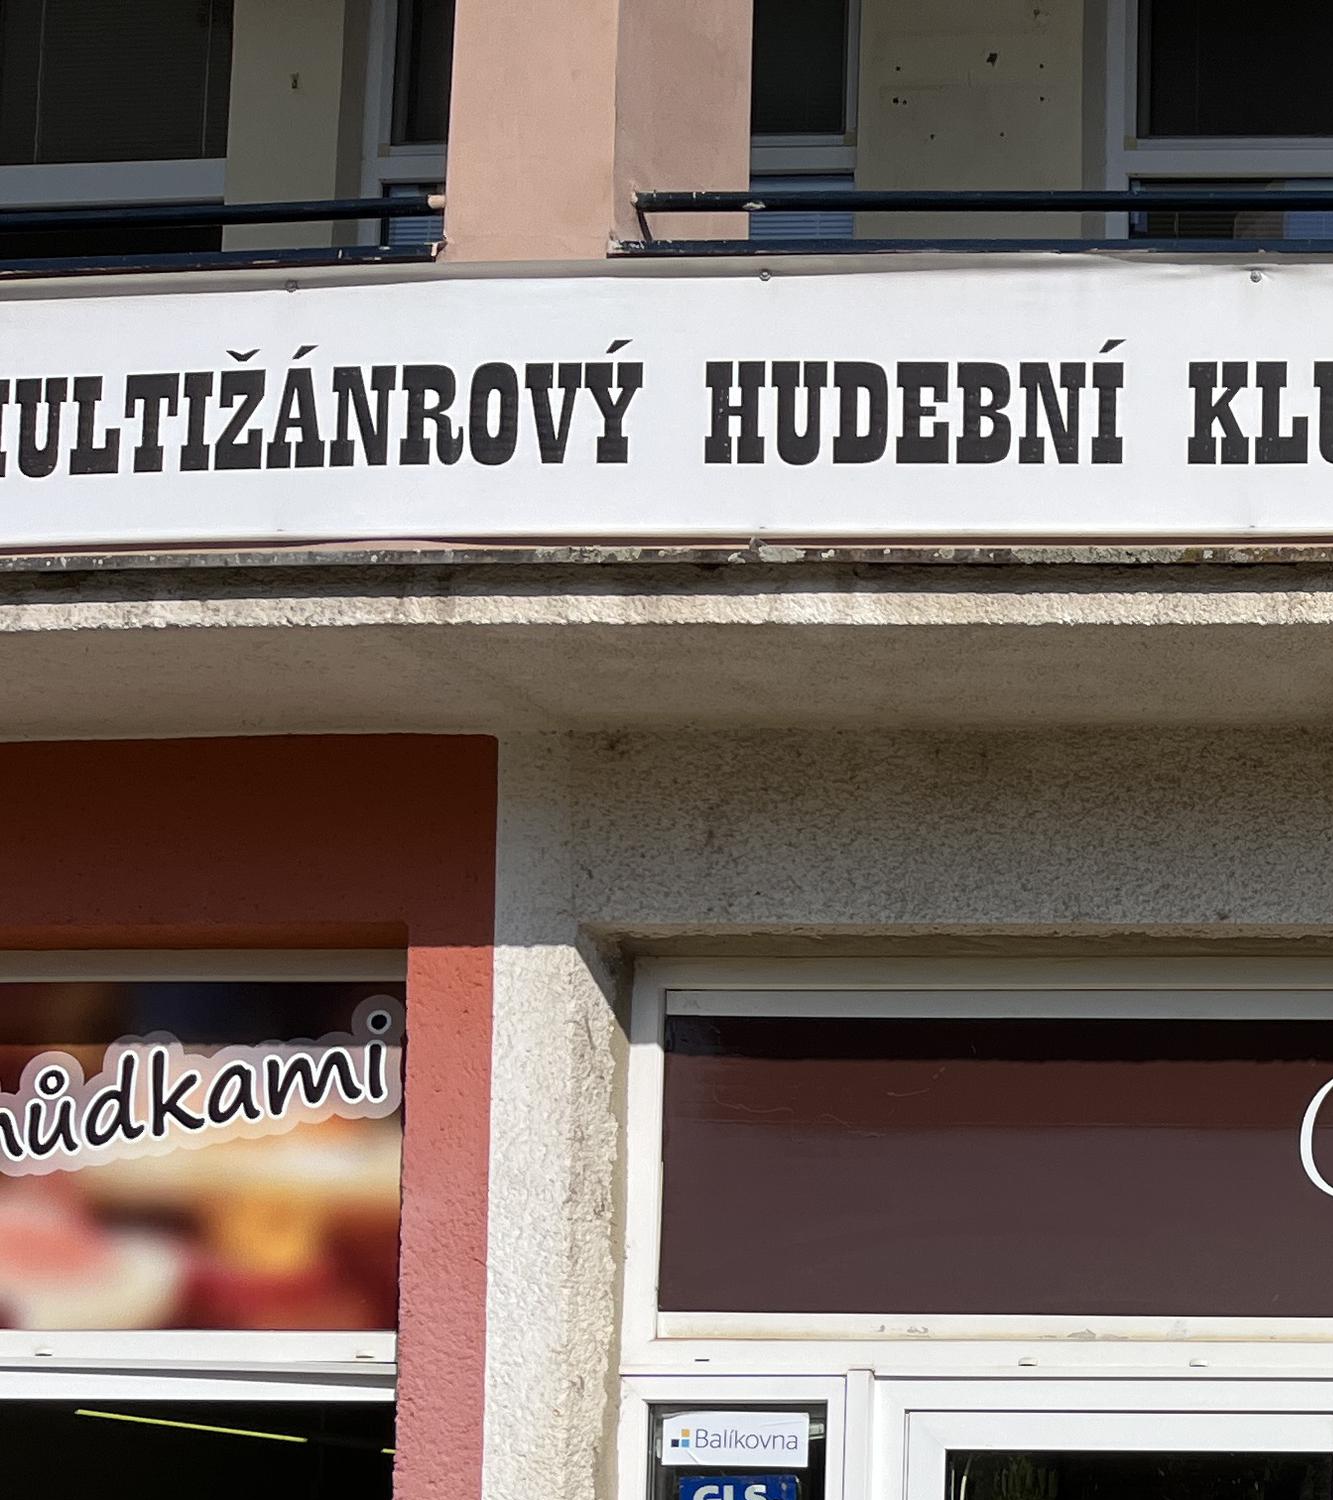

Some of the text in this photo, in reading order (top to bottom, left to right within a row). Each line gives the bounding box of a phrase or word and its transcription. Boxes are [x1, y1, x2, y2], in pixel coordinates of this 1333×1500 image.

[0, 338, 644, 479] ULTIŽÁNROVÝ
[704, 338, 1127, 466] HUDEBNÍ
[695, 1428, 798, 1450] Balíkovna
